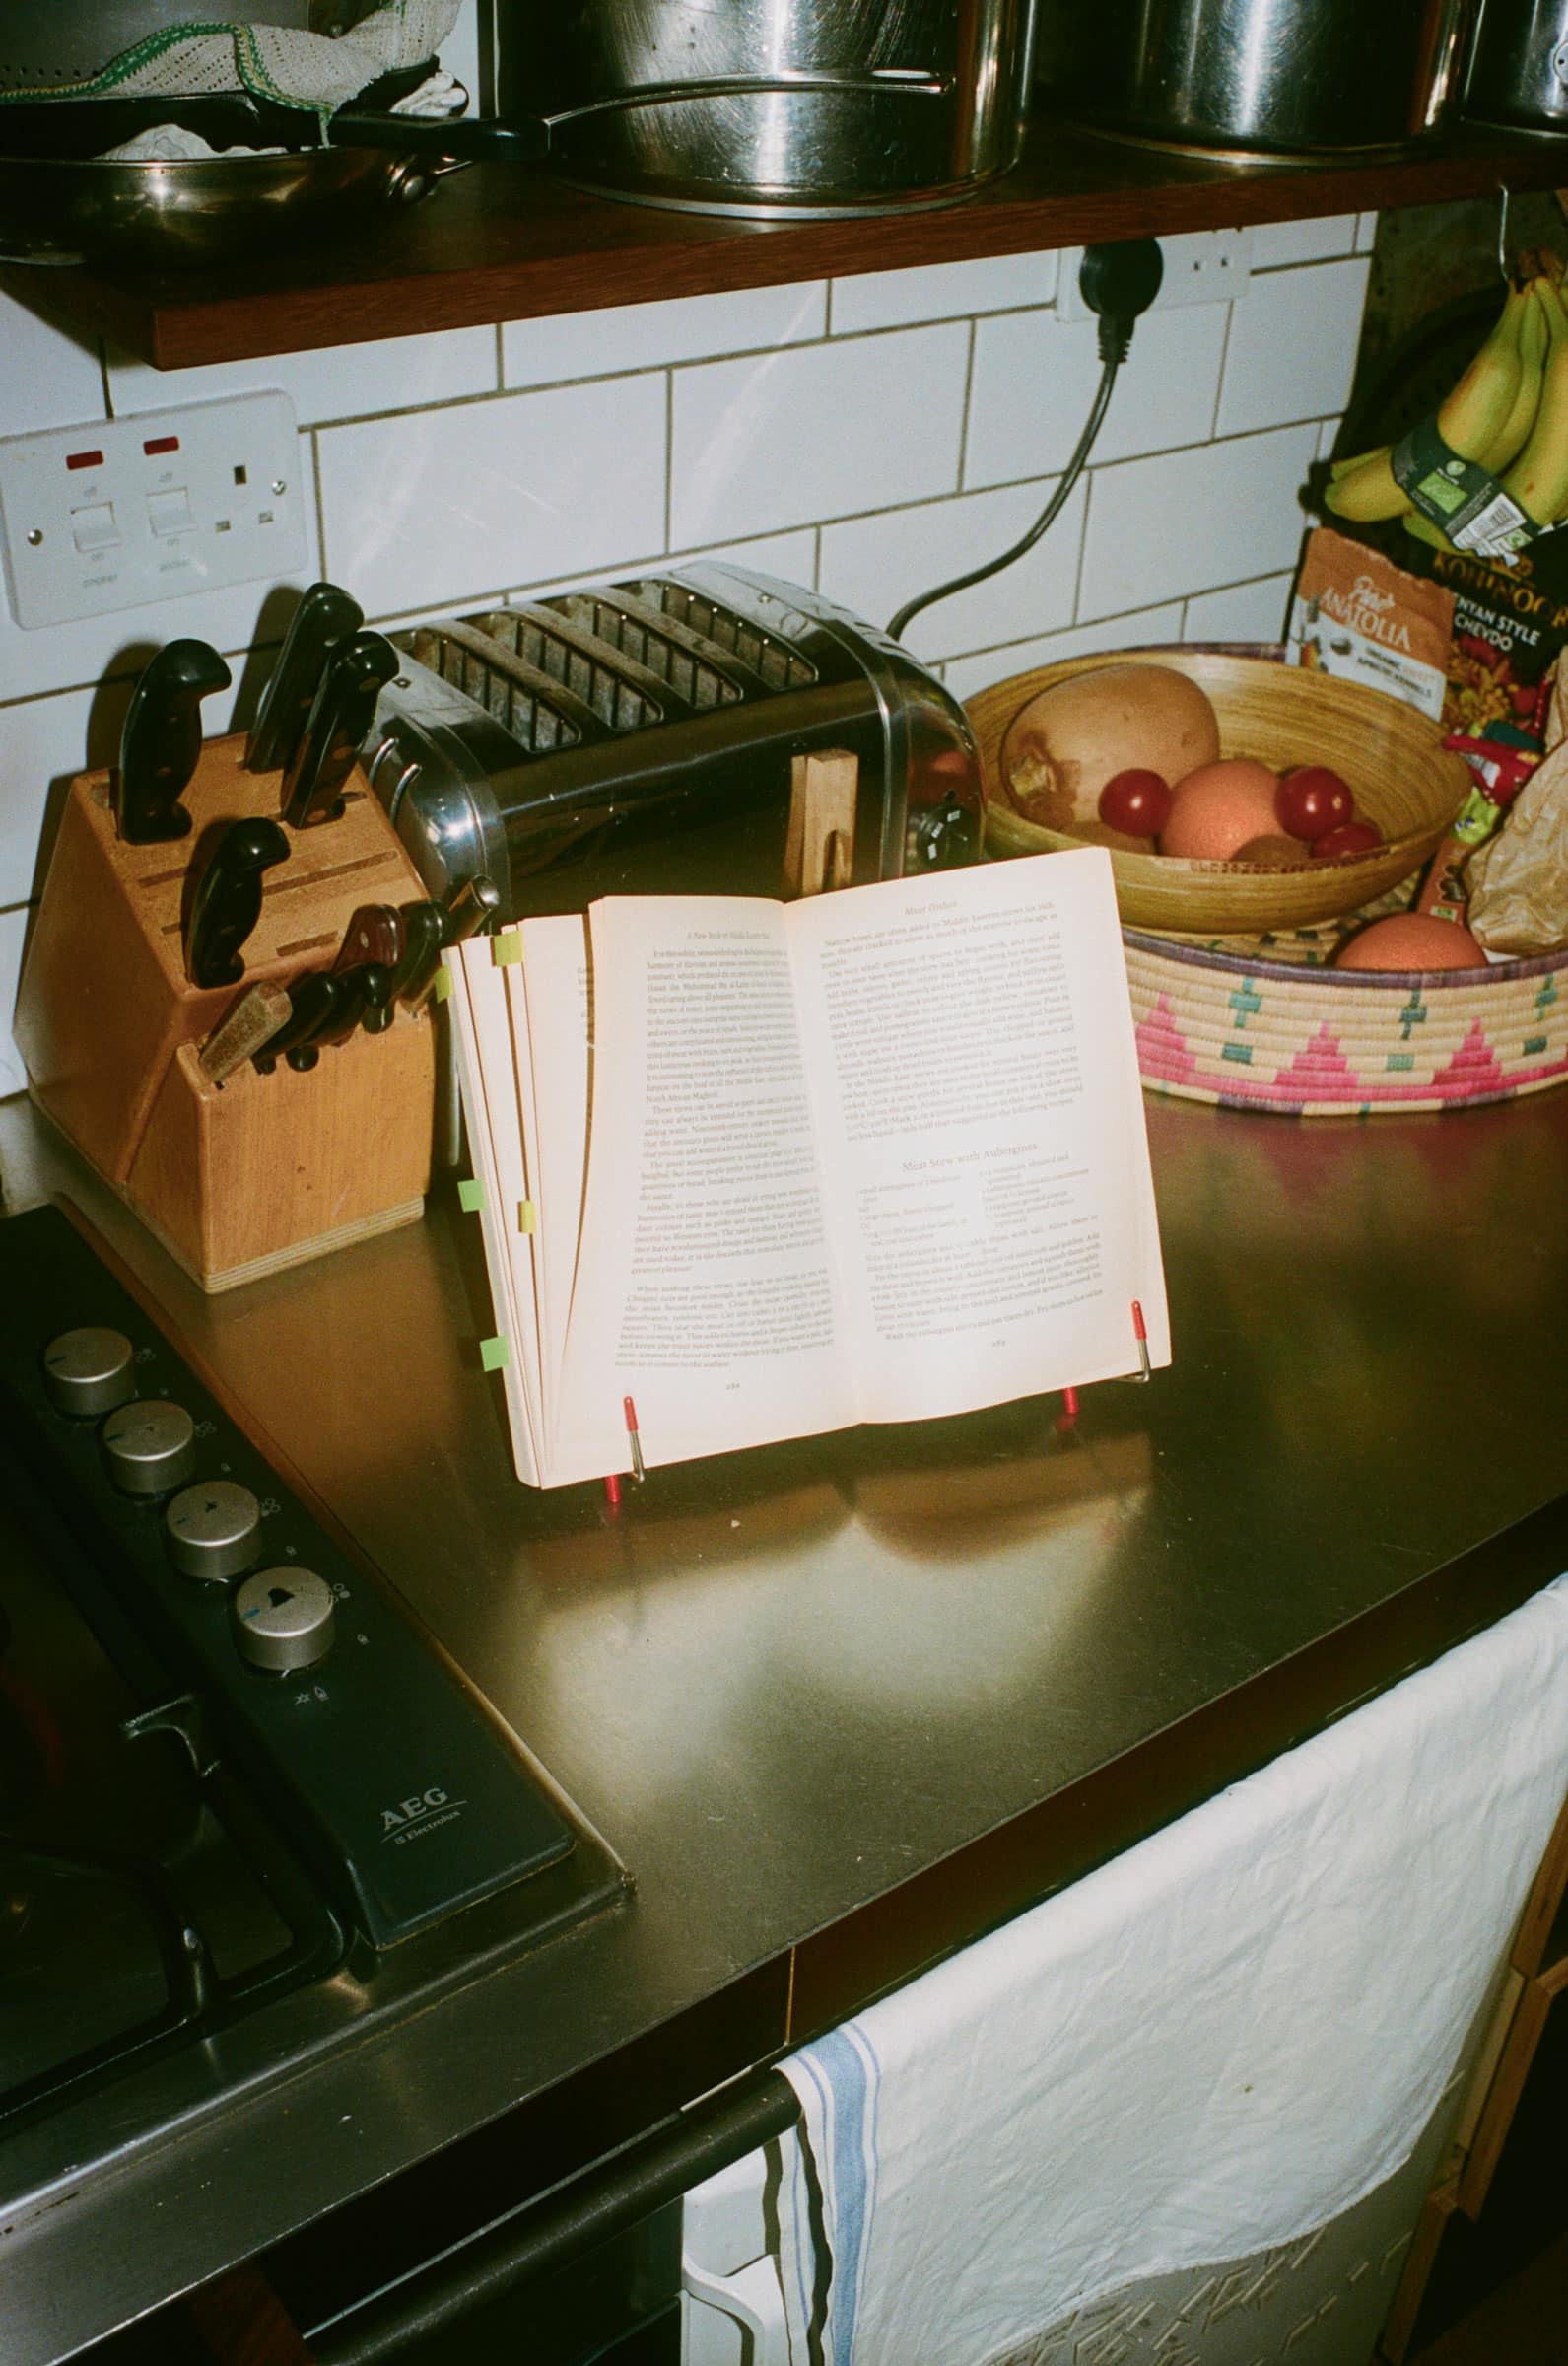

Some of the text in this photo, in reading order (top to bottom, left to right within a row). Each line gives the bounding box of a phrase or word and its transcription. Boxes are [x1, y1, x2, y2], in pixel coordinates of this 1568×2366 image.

[1324, 588, 1411, 652] ANATOLIA
[1454, 592, 1541, 646] NYAN STYLE
[1454, 612, 1513, 651] CHEVDO
[902, 1141, 1038, 1173] Meat Stew with Aubergines
[380, 1788, 448, 1830] AEG
[406, 1811, 460, 1840] Electrolux
